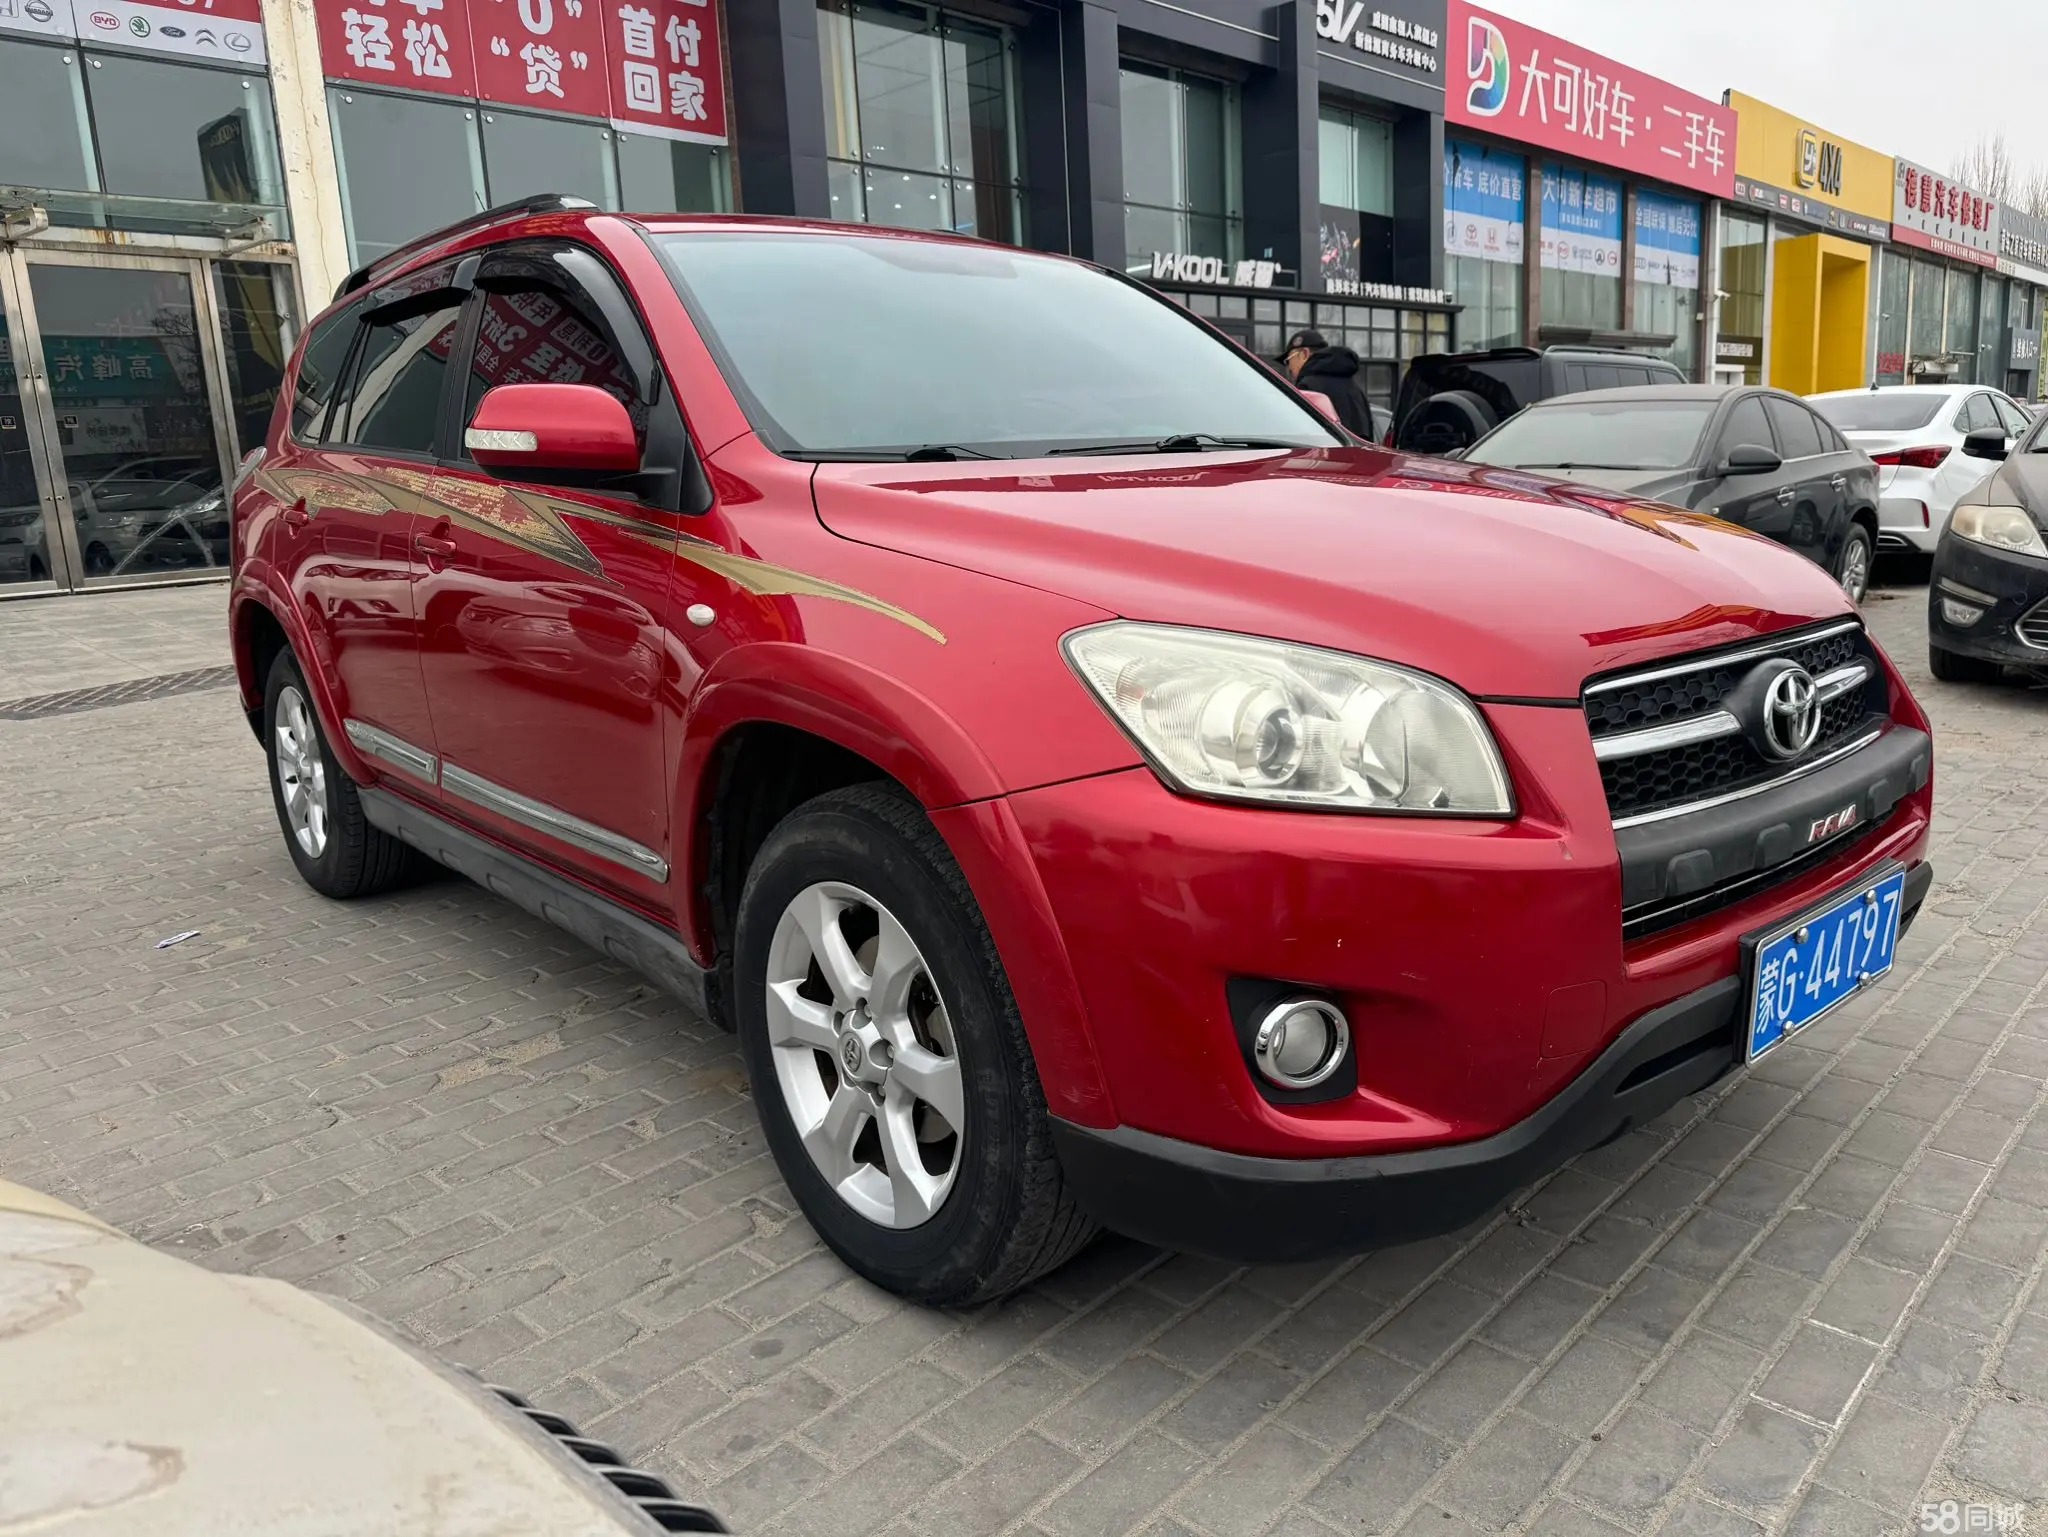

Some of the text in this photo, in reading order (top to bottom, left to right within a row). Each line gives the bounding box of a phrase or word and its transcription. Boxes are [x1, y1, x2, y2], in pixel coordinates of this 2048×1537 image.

[93, 16, 116, 27] BYD
[618, 4, 702, 67] 首付
[341, 8, 453, 79] 轻松
[623, 60, 708, 121] 回家
[1478, 172, 1521, 201] 底价直营
[1543, 174, 1617, 216] 大可新车超市
[1152, 251, 1230, 285] V-KOOL
[1808, 804, 1857, 842] RAV4
